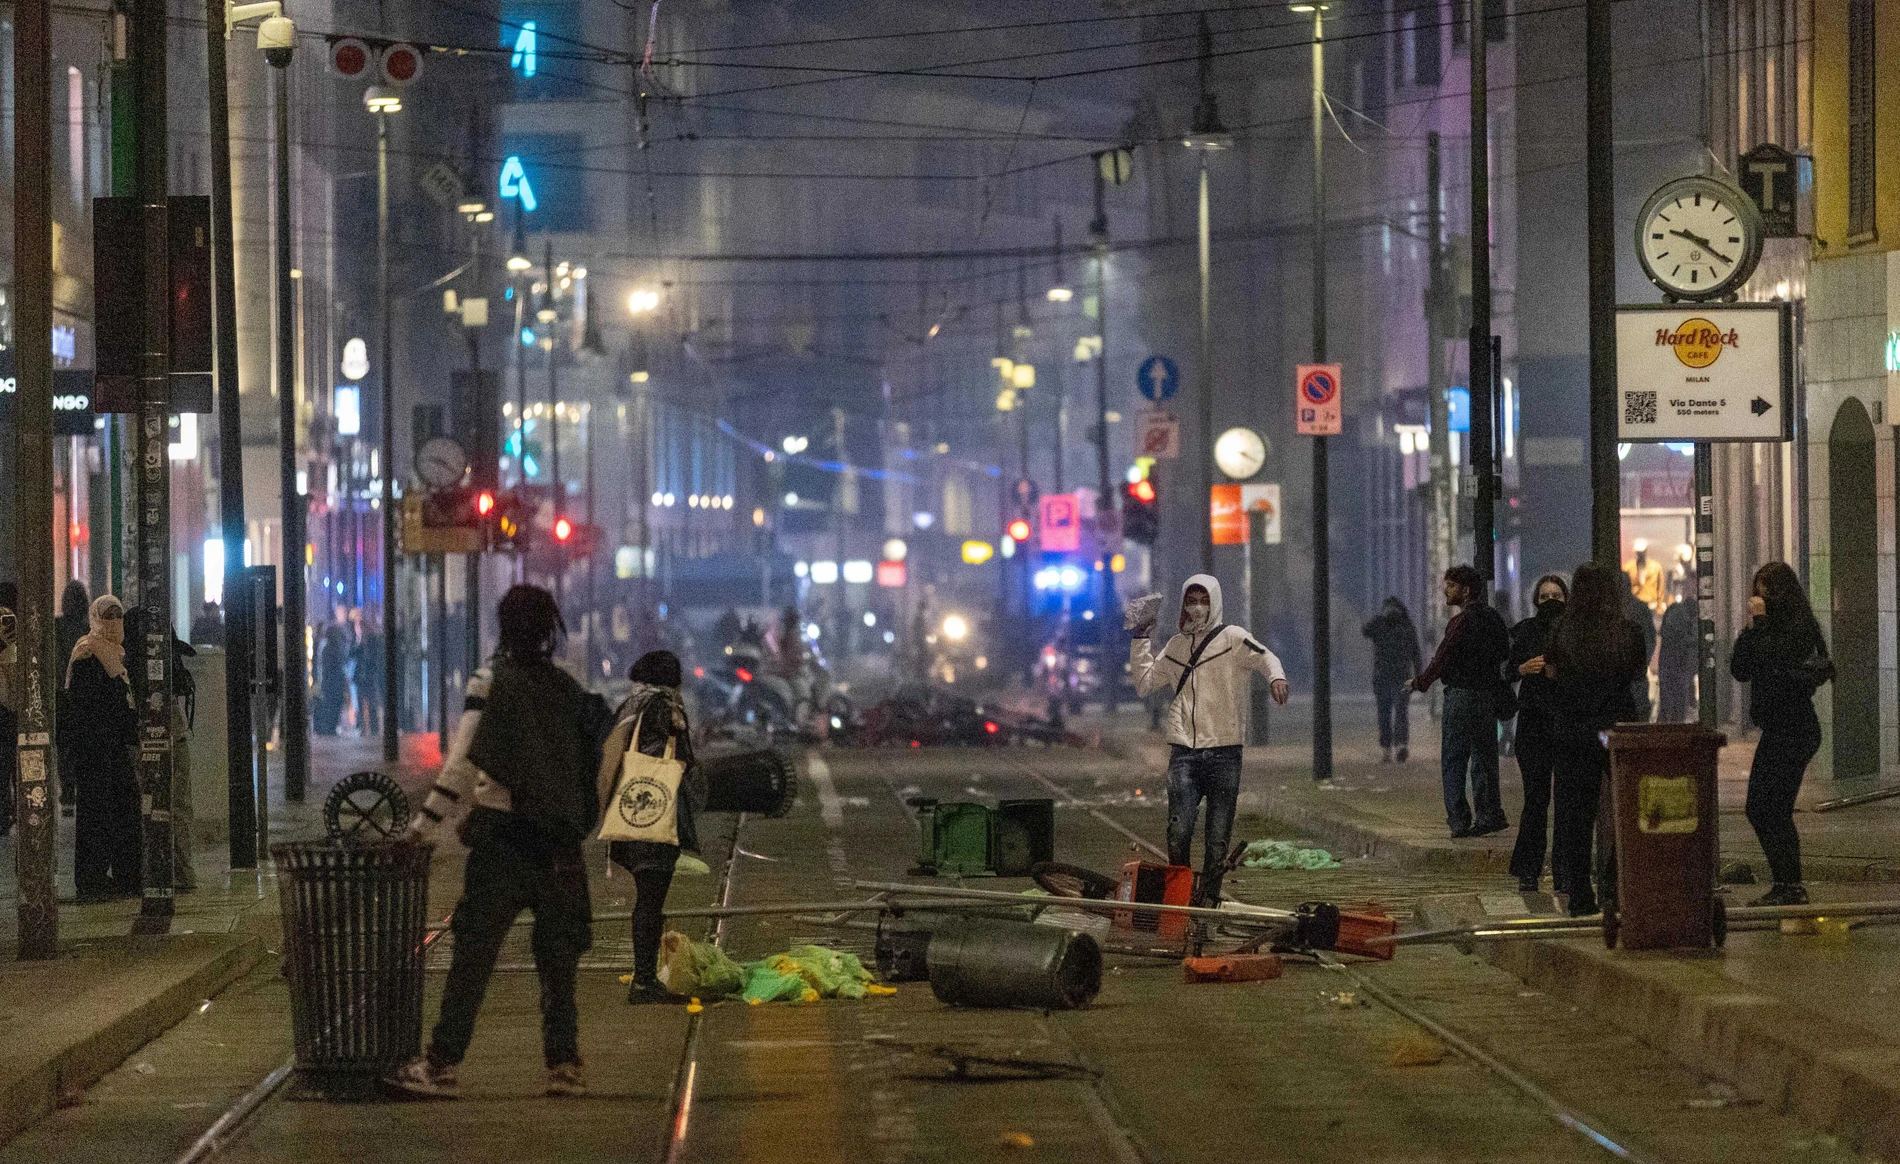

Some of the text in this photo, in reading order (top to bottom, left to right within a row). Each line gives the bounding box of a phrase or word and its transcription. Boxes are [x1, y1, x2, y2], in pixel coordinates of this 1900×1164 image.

[1656, 328, 1739, 348] Hard Rock
[1687, 351, 1709, 359] CAFE
[53, 395, 89, 411] NGO
[1670, 399, 1686, 407] Via
[1689, 399, 1717, 407] Dante
